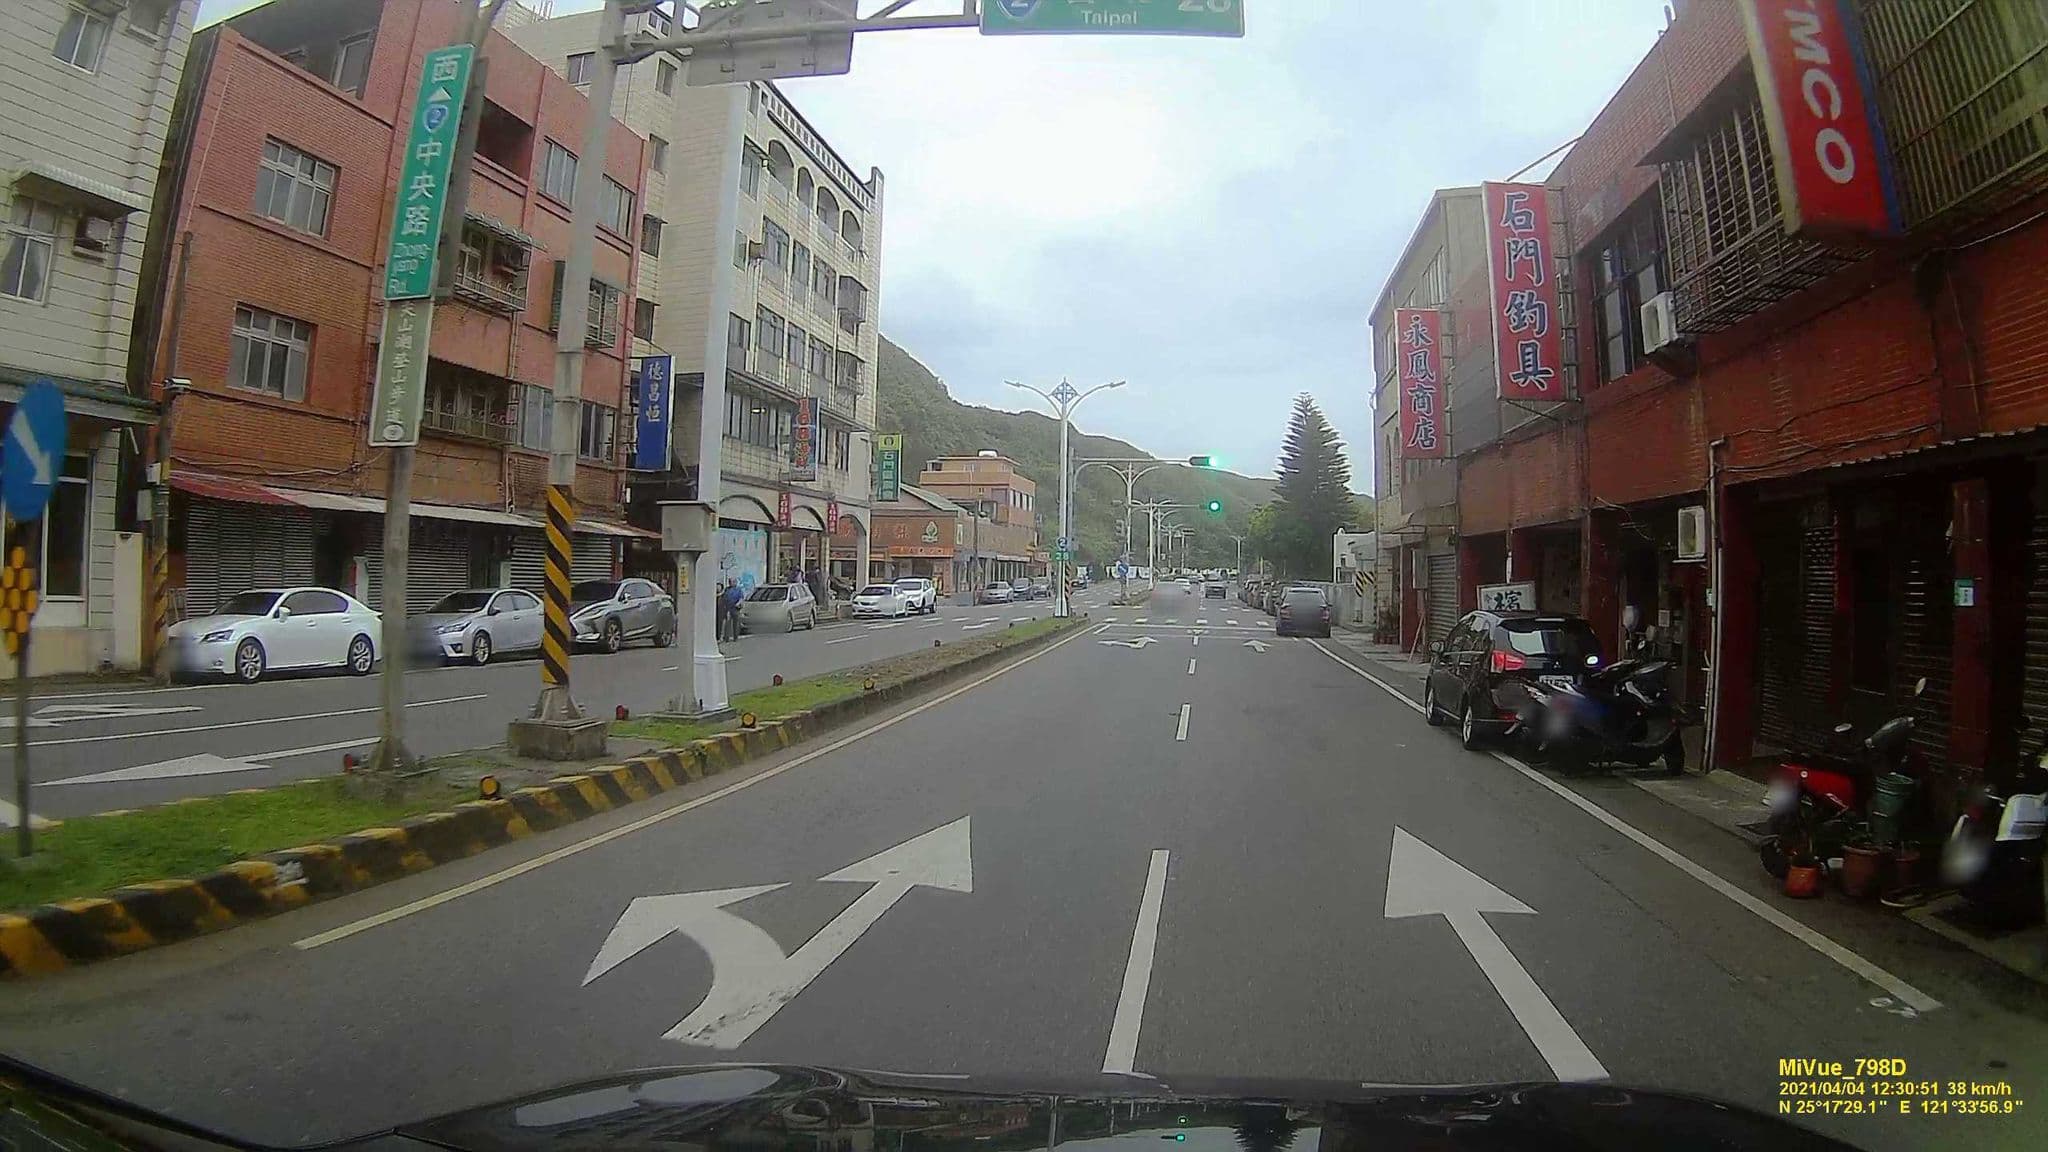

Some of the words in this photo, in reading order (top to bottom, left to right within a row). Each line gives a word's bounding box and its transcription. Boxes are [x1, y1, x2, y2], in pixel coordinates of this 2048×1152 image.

[431, 54, 462, 84] 西
[1081, 9, 1137, 26] Taipei
[1786, 0, 1855, 184] MCO
[401, 138, 442, 236] 中央路
[1501, 191, 1554, 391] 石門釣具
[1403, 314, 1437, 450] 永鳳商店
